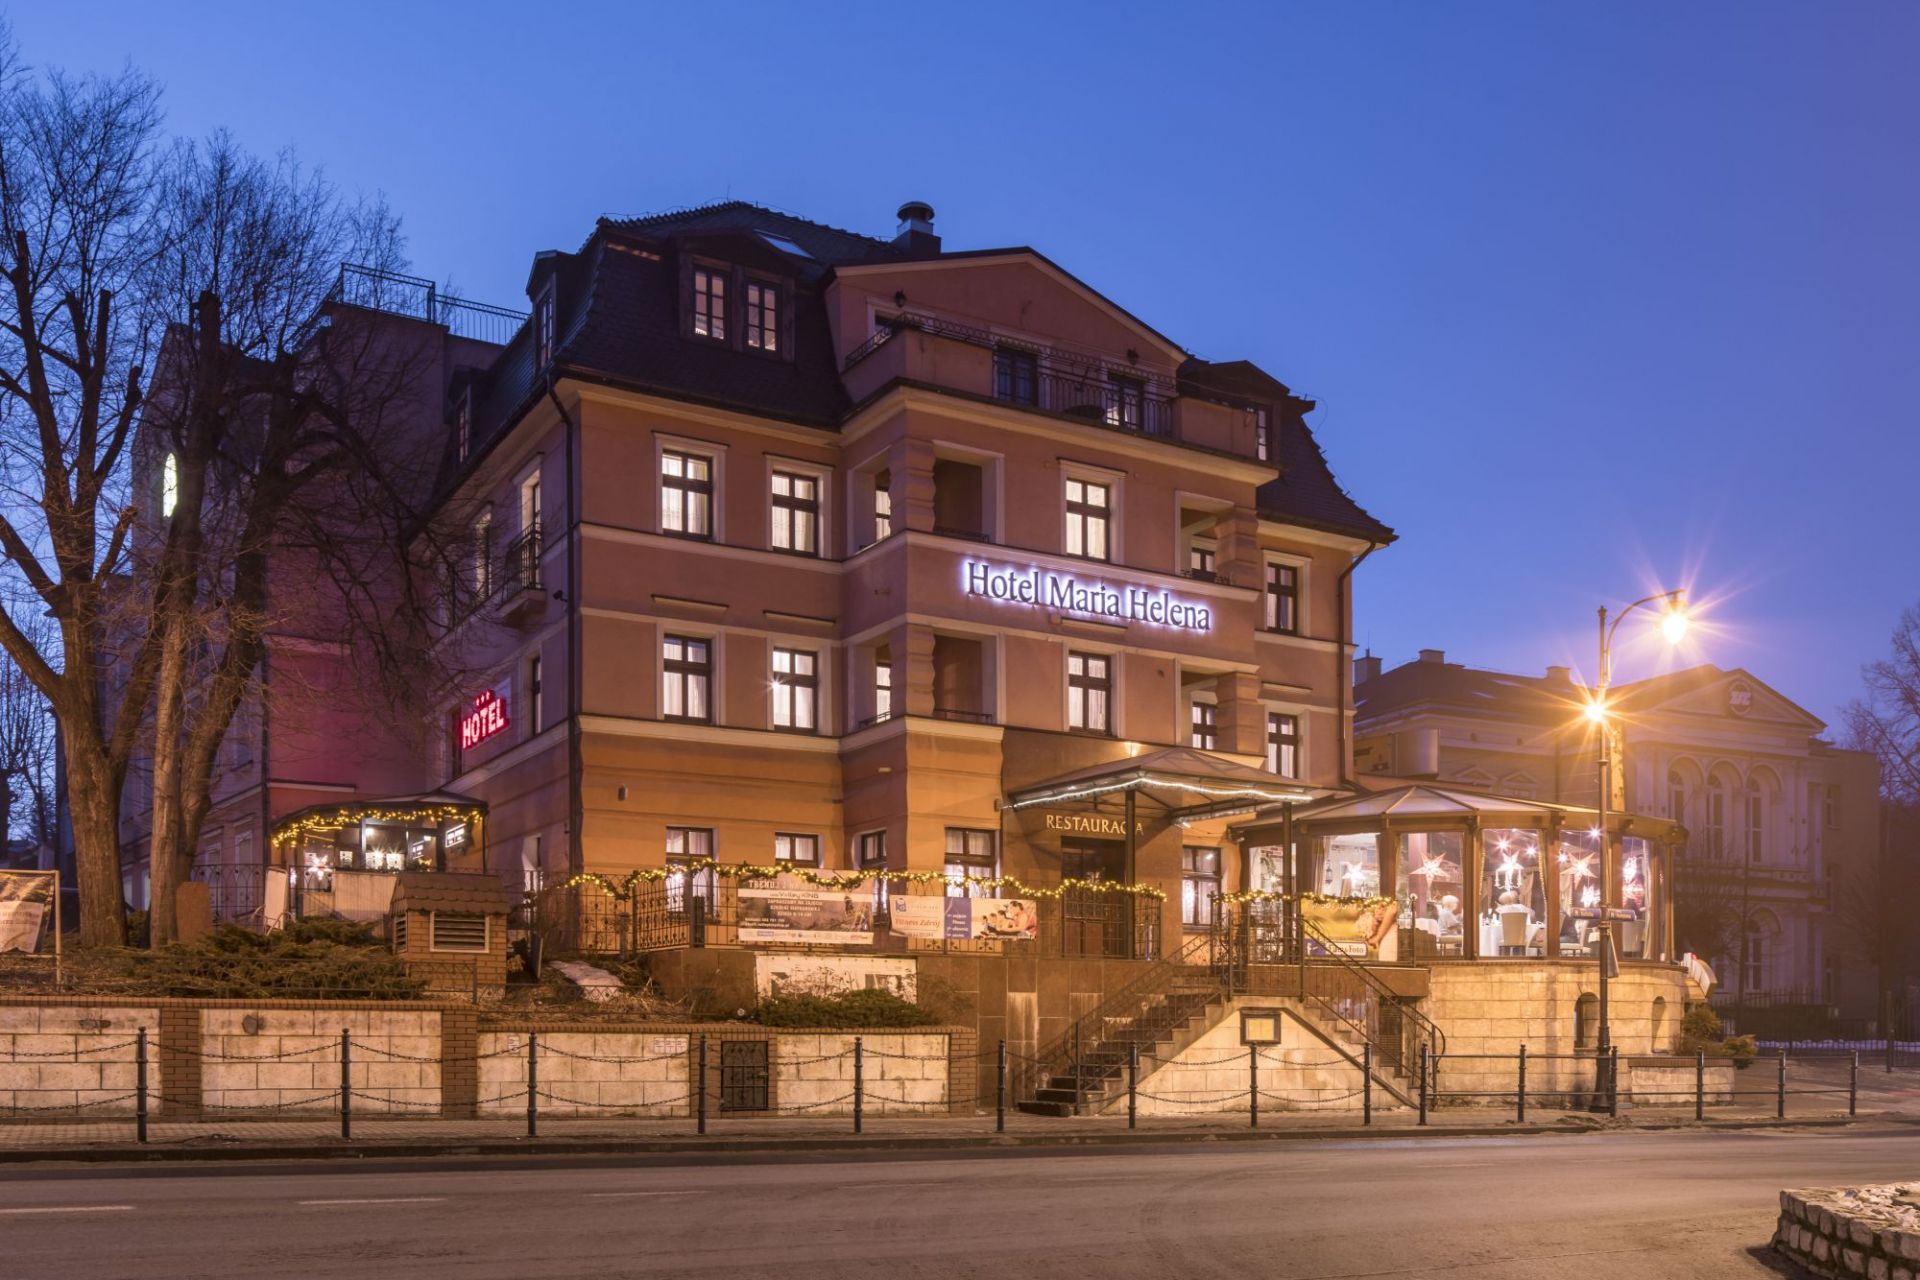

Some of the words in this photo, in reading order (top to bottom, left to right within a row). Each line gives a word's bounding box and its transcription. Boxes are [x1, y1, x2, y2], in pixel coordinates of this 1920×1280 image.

[967, 561, 1040, 605] Hotel
[1050, 576, 1120, 616] Maria
[1130, 589, 1210, 631] Helena
[462, 698, 504, 749] HOTEL
[1046, 814, 1144, 836] RESTAURACA
